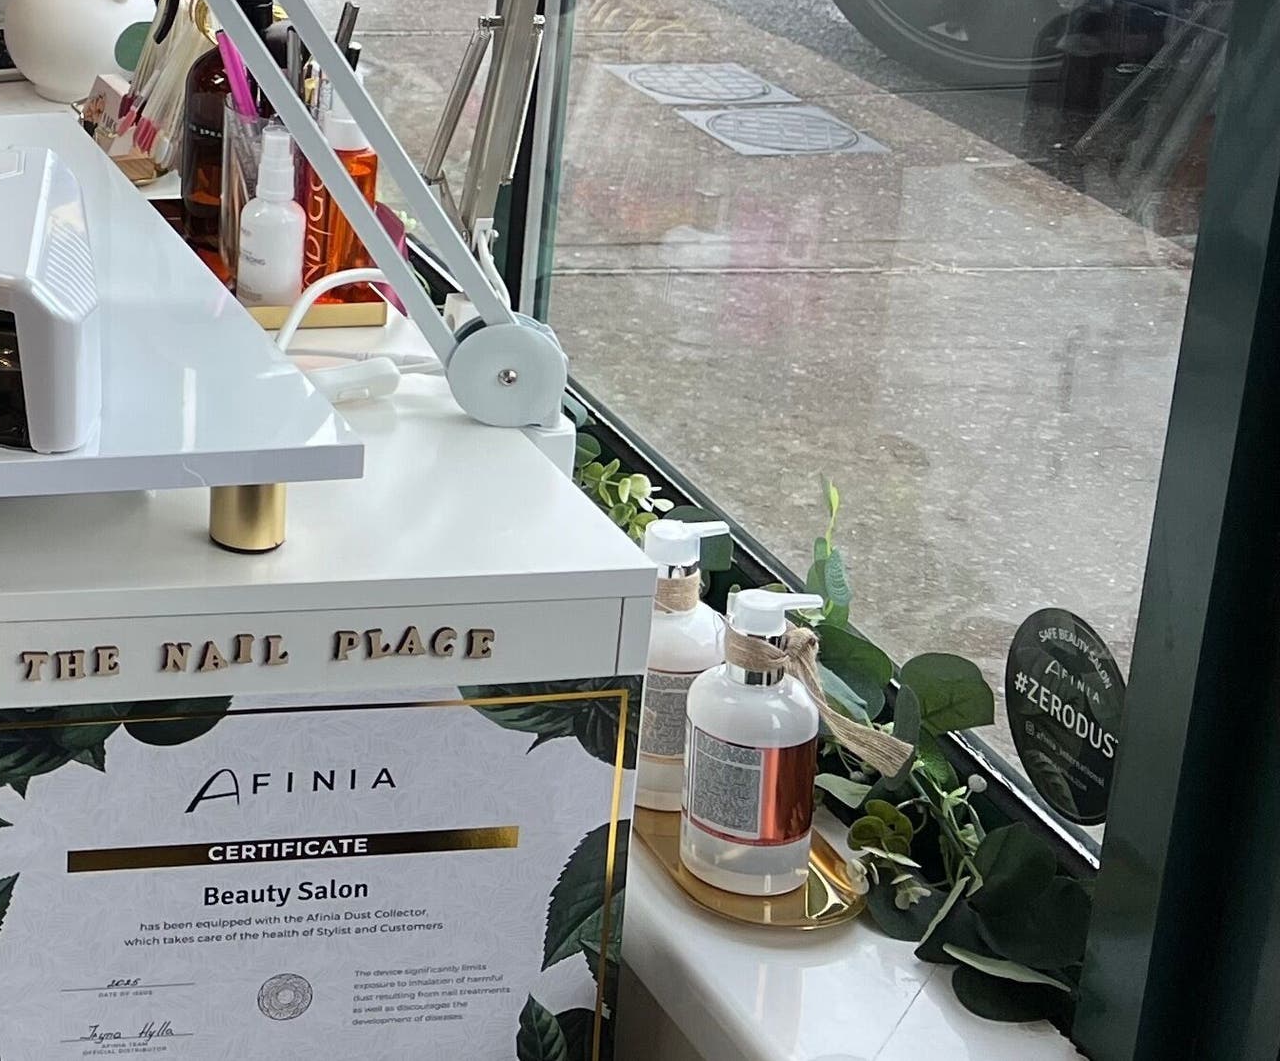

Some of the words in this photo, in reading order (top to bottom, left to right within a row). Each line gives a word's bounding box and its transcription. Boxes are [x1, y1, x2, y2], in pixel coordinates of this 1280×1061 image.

[20, 646, 121, 682] THE
[160, 635, 290, 673] NAIL
[333, 625, 496, 662] PLACE
[1038, 627, 1057, 643] SAFE
[1058, 628, 1089, 653] BEAUTY
[1088, 650, 1113, 690] SALON
[1044, 660, 1100, 704] AFINIA
[1014, 671, 1119, 759] #ZERODUS
[184, 767, 396, 813] AFINIA
[208, 838, 369, 861] CERTIFICATE
[204, 885, 291, 907] Beauty
[297, 879, 369, 901] Salon
[140, 922, 160, 931] has
[163, 920, 193, 930] been
[196, 916, 252, 930] equipped
[255, 915, 281, 925] with
[284, 914, 303, 924] the
[307, 912, 341, 922] Afinia
[344, 911, 372, 921] Dust
[374, 908, 429, 919] Collector,
[124, 937, 160, 947] which
[163, 935, 194, 944] takes
[197, 935, 222, 943] care
[225, 932, 237, 941] of
[240, 931, 260, 940] the
[262, 929, 299, 939] health
[302, 927, 315, 937] of
[316, 926, 352, 938] Stylist
[354, 924, 377, 934] and
[380, 921, 444, 933] Customers
[353, 981, 396, 990] exposure
[408, 977, 454, 987] inhalation
[455, 976, 465, 984] of
[467, 974, 504, 983] harmful
[372, 969, 403, 977] device
[404, 965, 460, 976] significantly
[461, 964, 487, 972] limits
[353, 994, 373, 1002] dust
[376, 992, 415, 1002] resulting
[417, 990, 439, 998] from
[441, 989, 458, 997] nail
[459, 987, 510, 996] treatments
[364, 1005, 383, 1013] well
[452, 1000, 468, 1008] the
[352, 1016, 412, 1026] development
[414, 1014, 424, 1022] of
